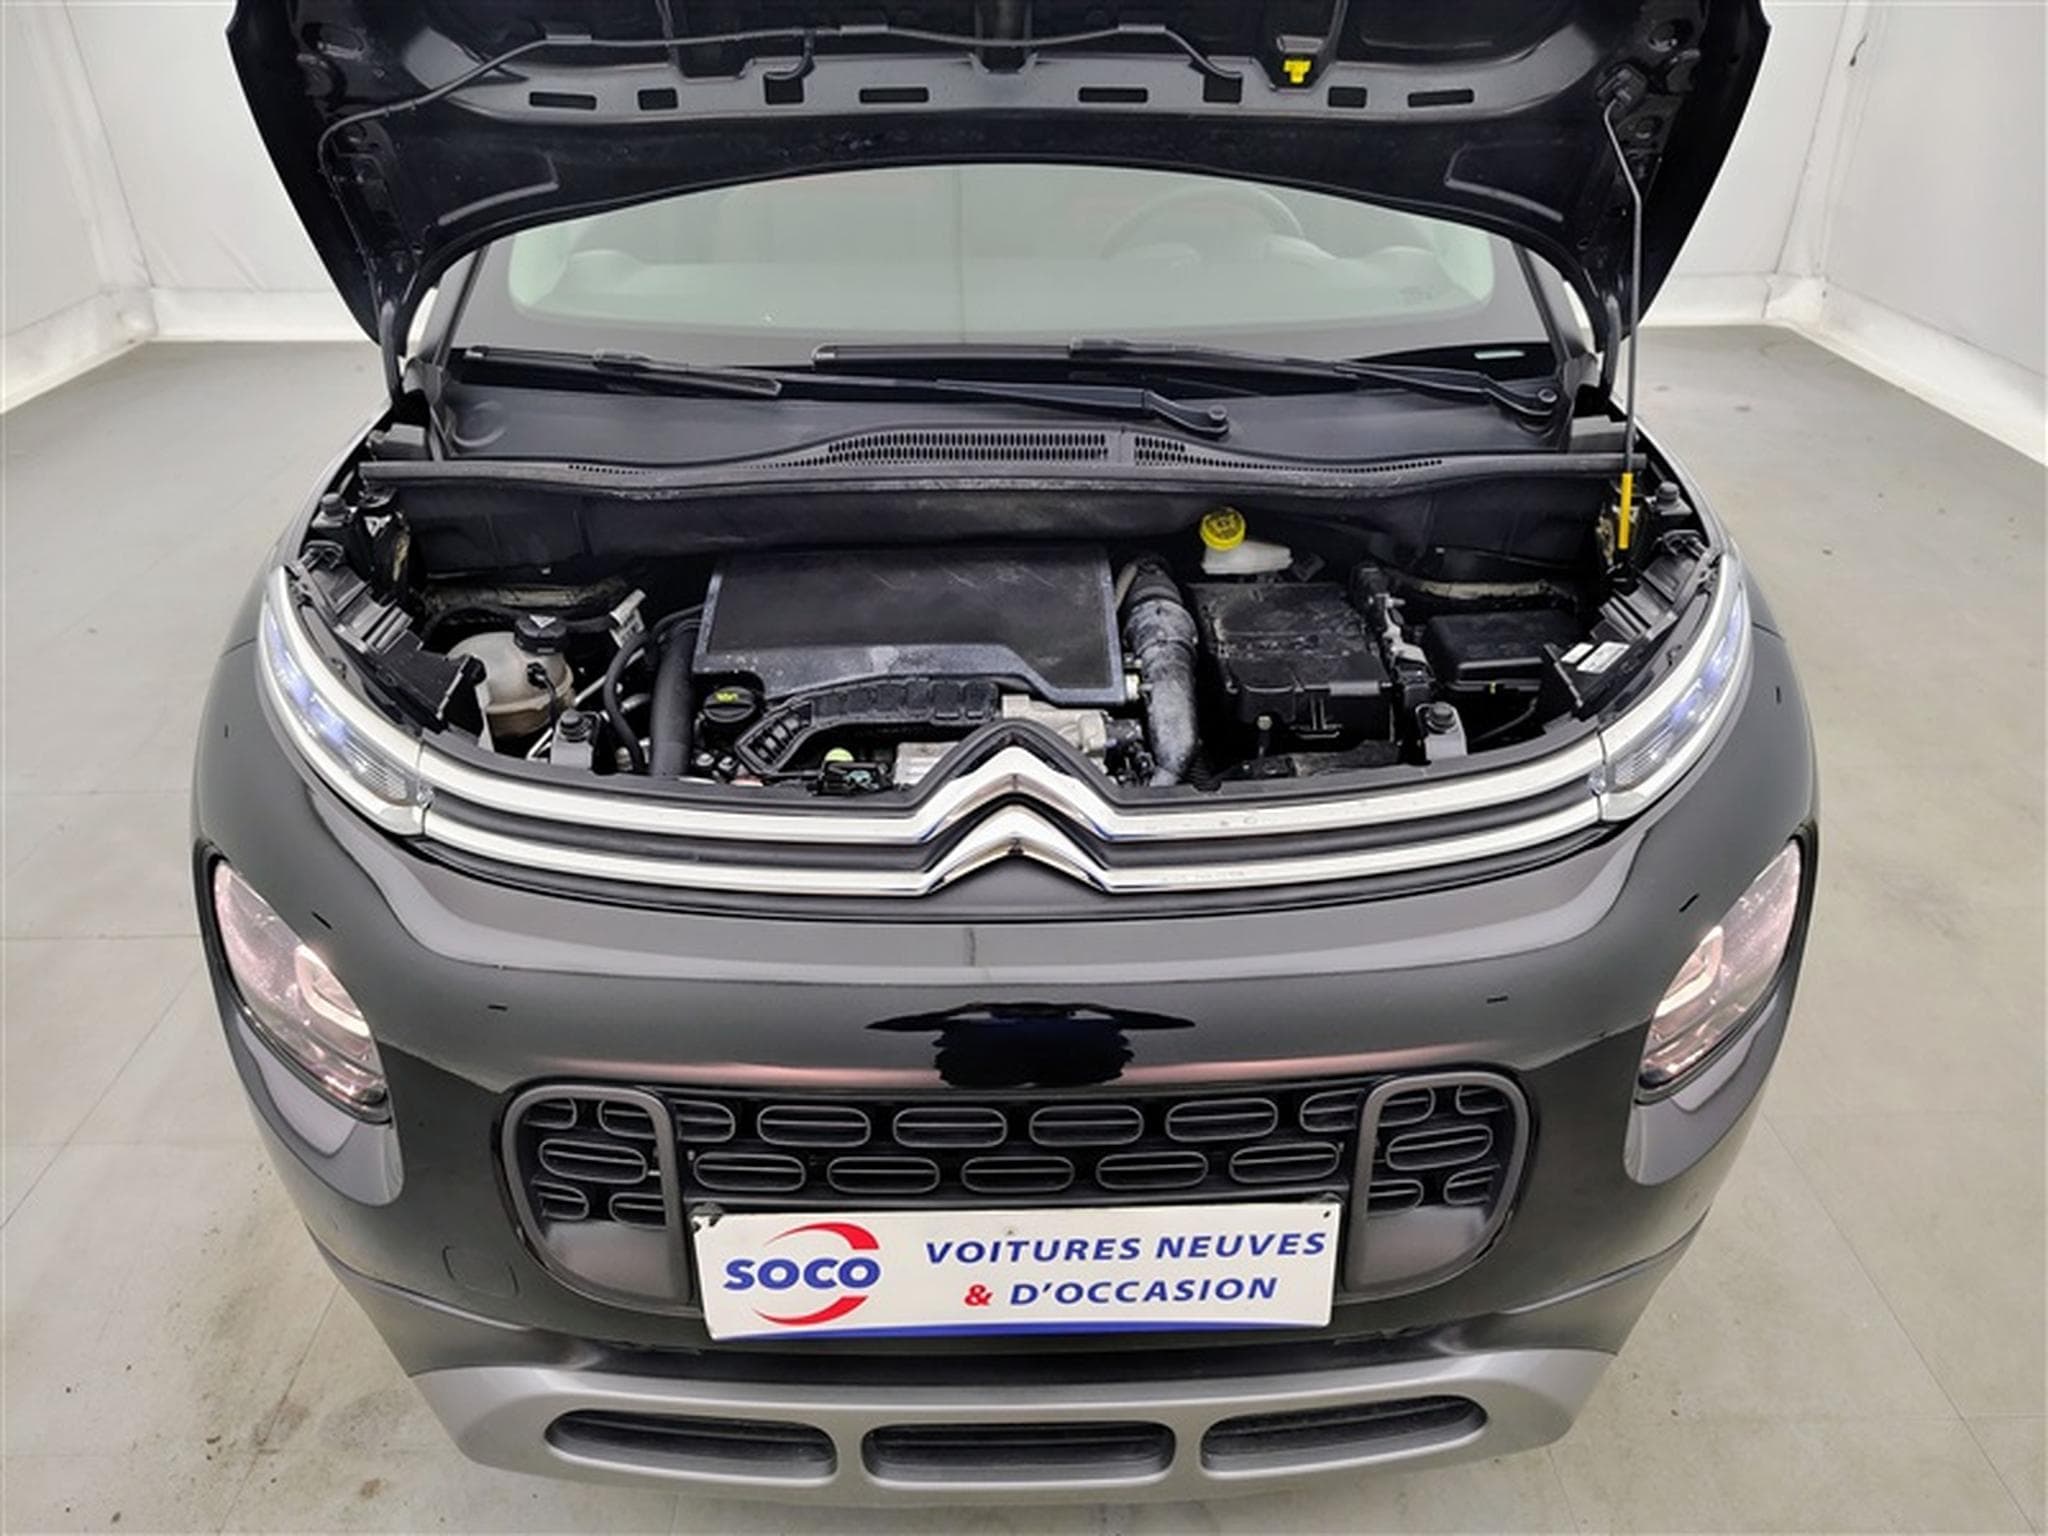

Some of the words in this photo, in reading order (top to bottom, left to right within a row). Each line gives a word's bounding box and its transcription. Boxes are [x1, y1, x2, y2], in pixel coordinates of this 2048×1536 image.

[926, 1237, 1140, 1264] VOITURES
[1156, 1232, 1326, 1258] NEUVES
[723, 1257, 881, 1291] SOCO
[962, 1283, 994, 1308] &
[1009, 1277, 1277, 1306] D'OCCASION
